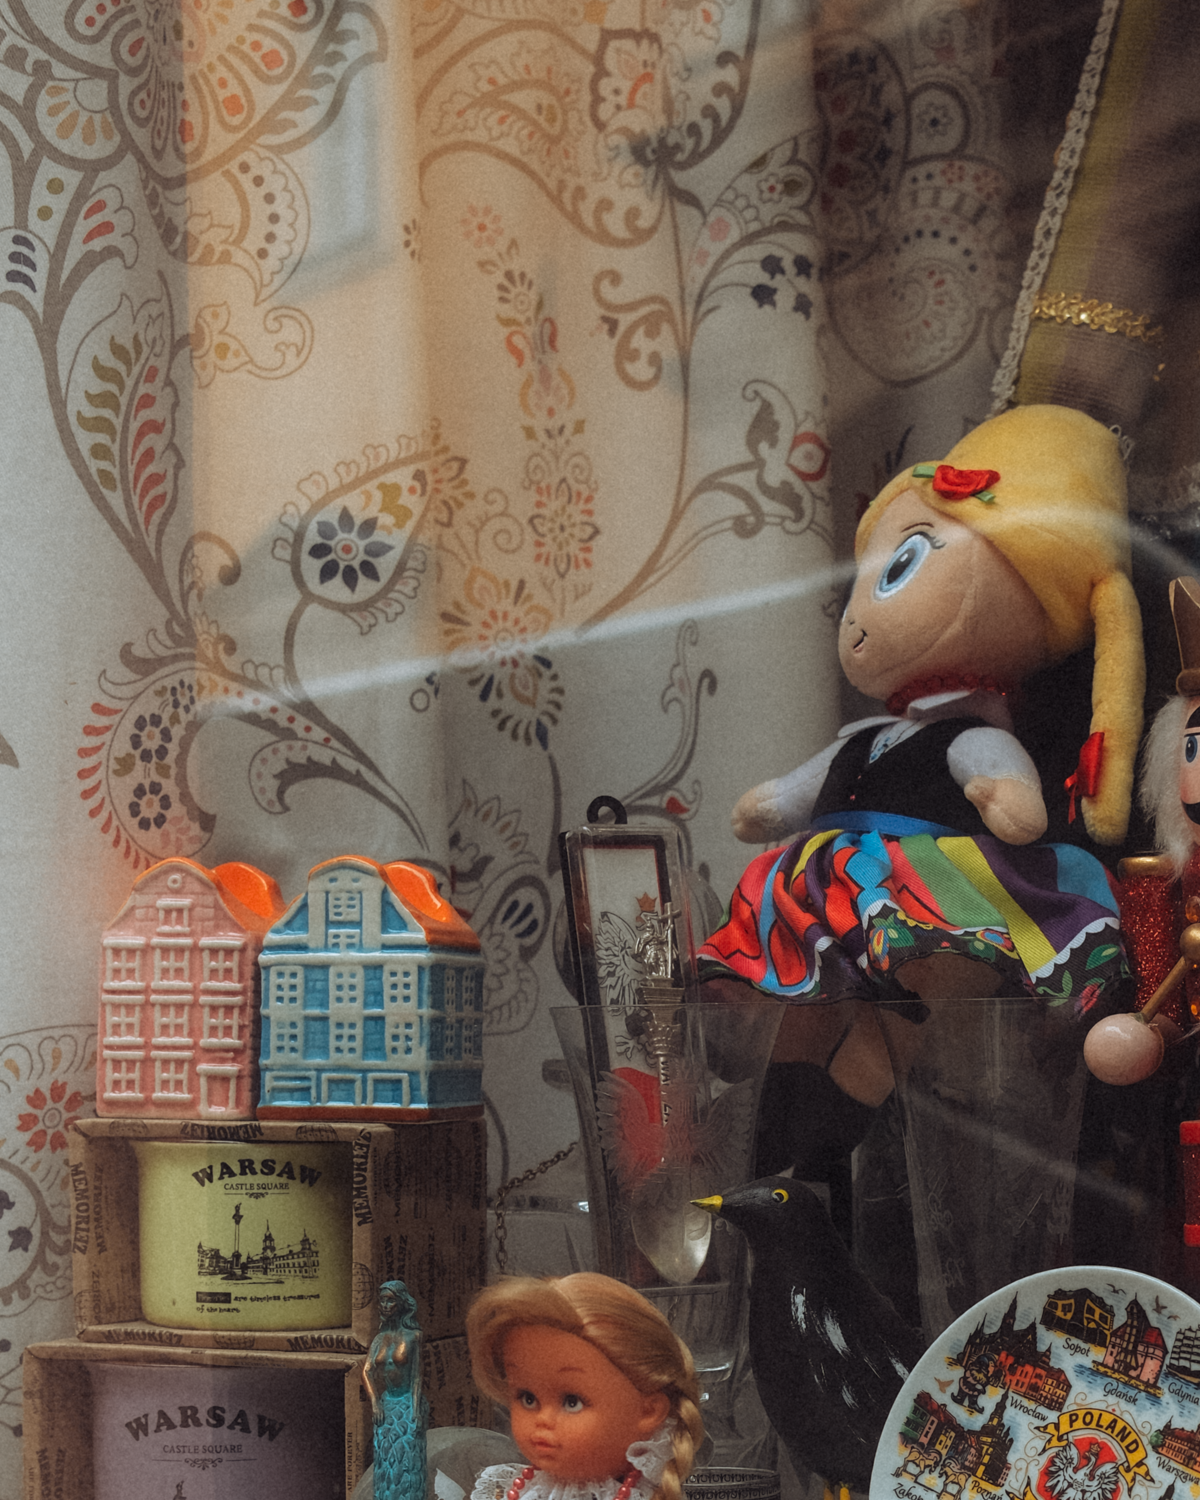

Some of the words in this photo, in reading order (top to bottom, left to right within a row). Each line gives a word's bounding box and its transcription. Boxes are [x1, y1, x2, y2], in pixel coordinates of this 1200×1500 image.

[191, 1158, 323, 1188] WARSAW
[224, 1183, 255, 1191] CASTLE
[256, 1182, 290, 1191] SQUARE
[1062, 1337, 1091, 1358] Sopot
[1103, 1381, 1139, 1406] Gdańsk
[1167, 1381, 1200, 1406] Gdynia
[1009, 1396, 1049, 1421] Wrocław
[124, 1404, 286, 1442] WARSAW
[1068, 1411, 1140, 1454] POLAND
[162, 1444, 200, 1454] CASTLE
[201, 1444, 243, 1454] SQUARE
[1155, 1455, 1200, 1485] Warszawa
